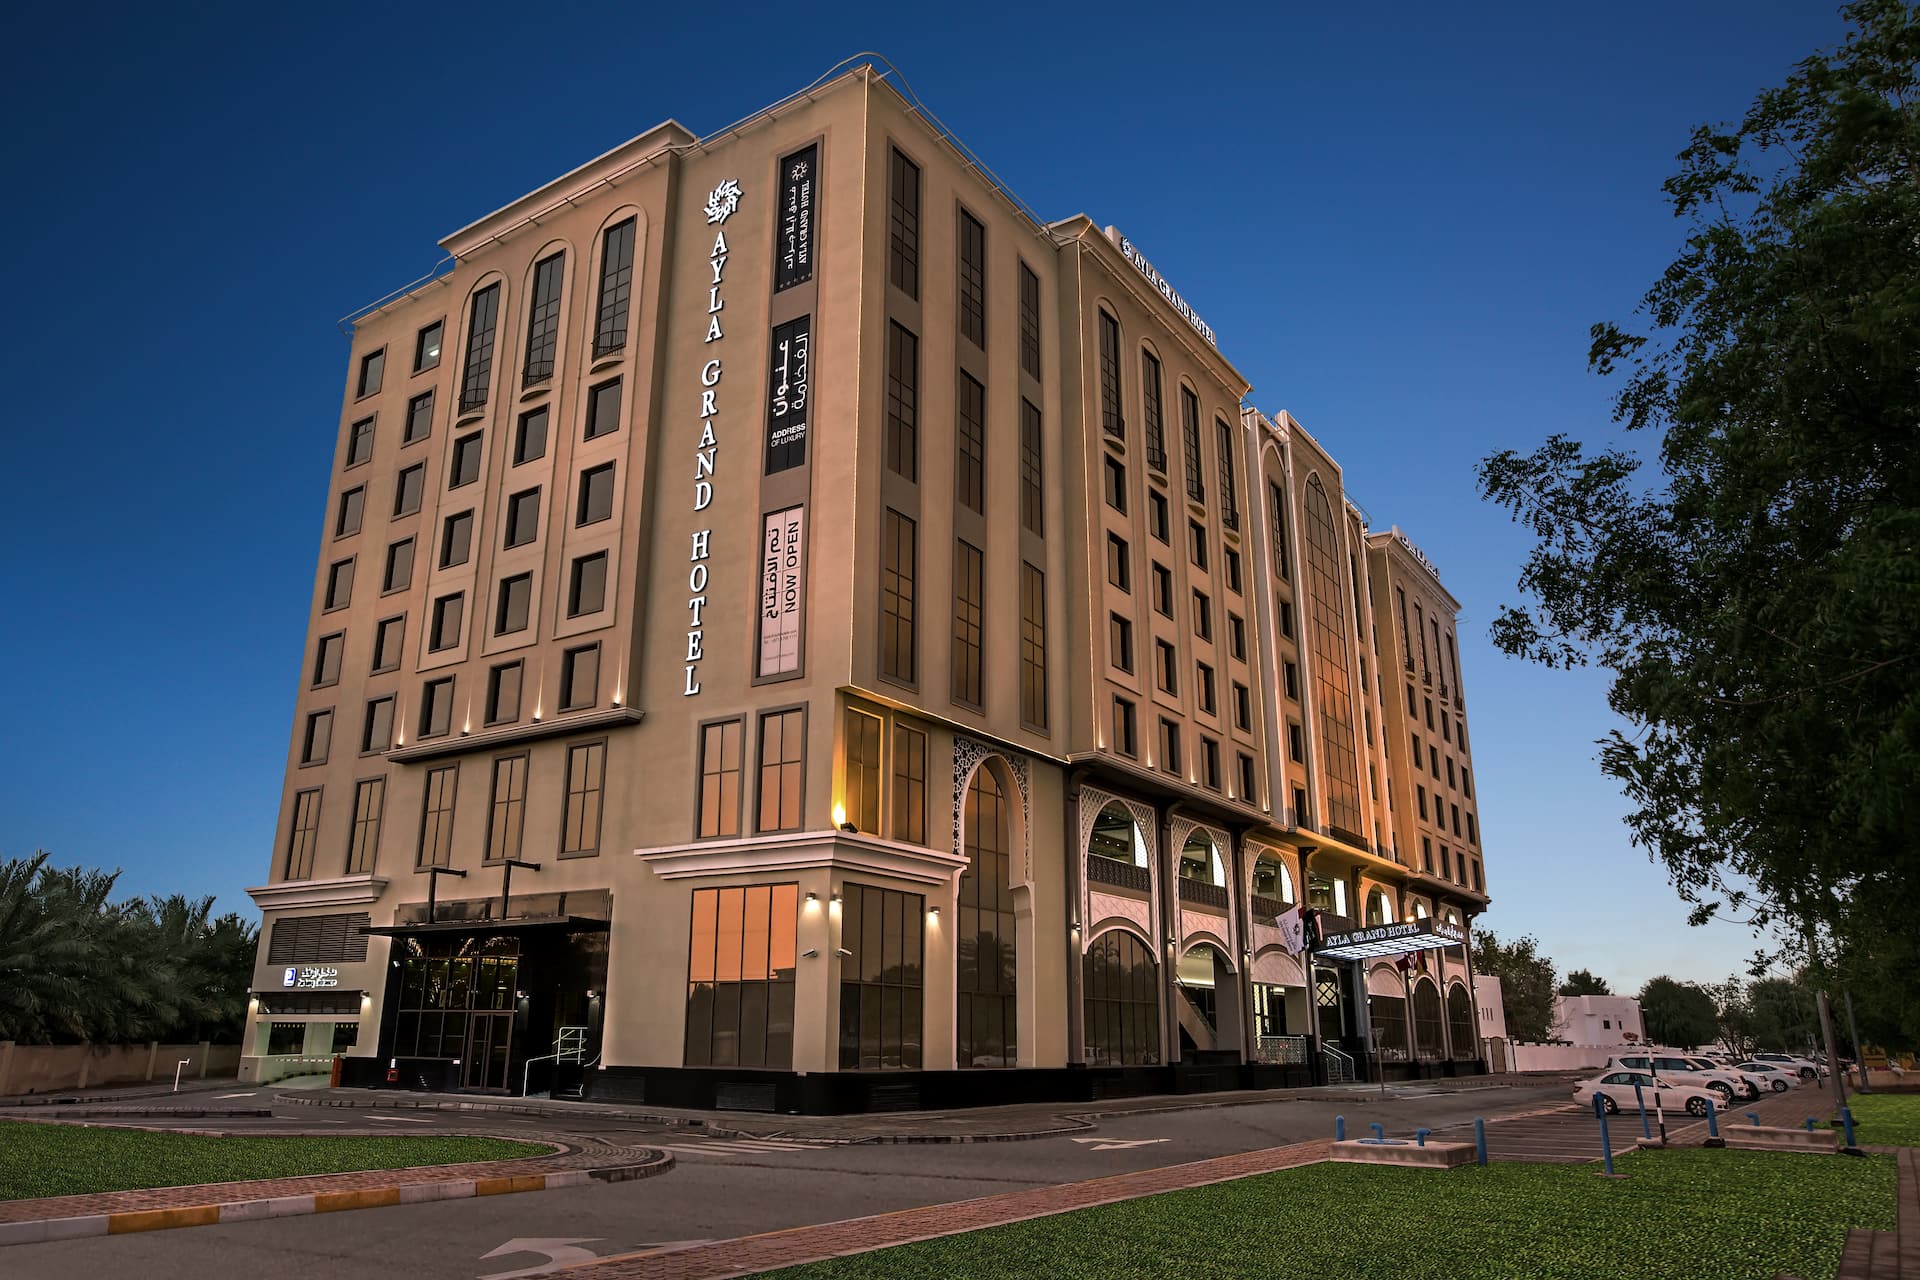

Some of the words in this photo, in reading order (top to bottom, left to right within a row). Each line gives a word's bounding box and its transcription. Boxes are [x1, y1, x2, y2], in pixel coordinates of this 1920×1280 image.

[800, 180, 810, 208] HOTEL
[799, 209, 809, 241] GRAND
[798, 241, 808, 264] AYLA
[704, 230, 728, 343] AYLA
[1133, 252, 1157, 286] AYLA
[1158, 278, 1189, 317] GRAND
[1190, 309, 1216, 346] HOTEL
[772, 339, 790, 417] عنوان
[791, 333, 809, 409] الفخامة
[693, 359, 721, 511] GRAND
[771, 422, 806, 440] ADDRESS
[771, 438, 780, 448] OF
[780, 431, 806, 445] LUXURY
[768, 528, 781, 553] تم
[786, 521, 799, 567] OPEN
[683, 529, 710, 696] HOTEL
[785, 575, 797, 613] NOW
[1326, 935, 1350, 947] AYLA
[1352, 927, 1386, 942] GRAND
[1387, 923, 1420, 938] HOTEL
